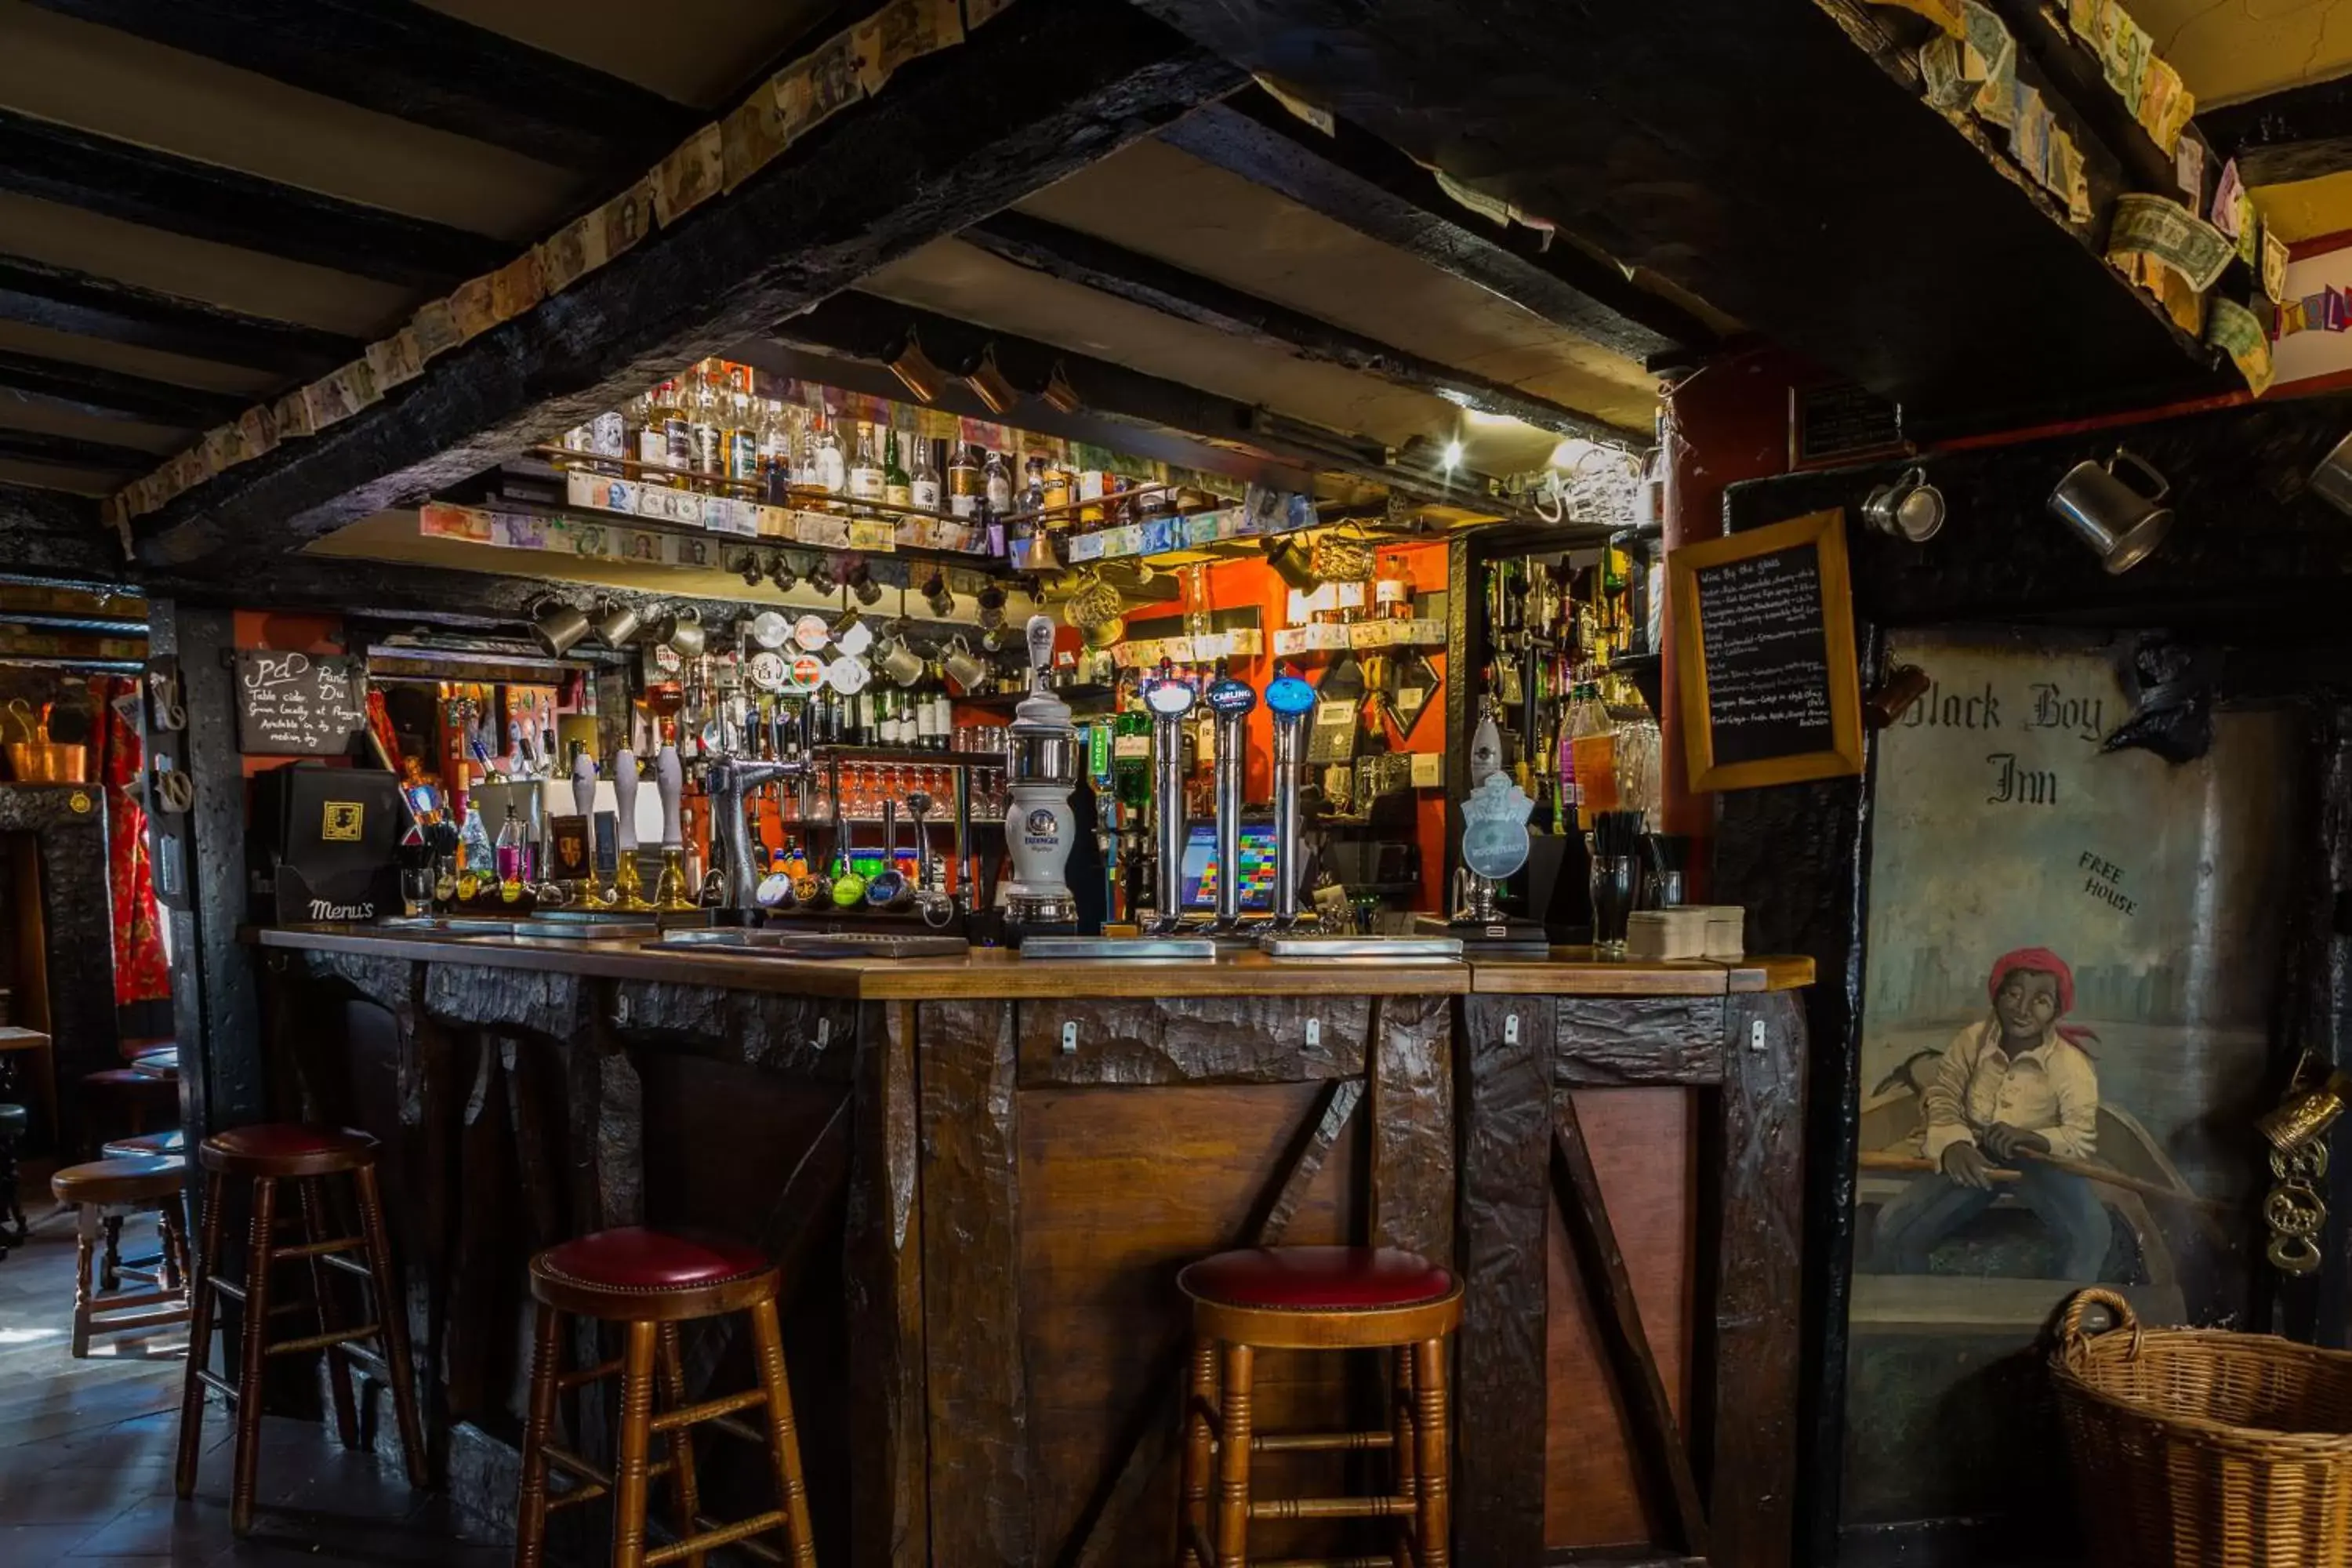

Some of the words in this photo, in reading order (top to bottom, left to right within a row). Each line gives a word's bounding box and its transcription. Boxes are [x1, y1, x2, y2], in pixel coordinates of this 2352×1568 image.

[1700, 572, 1721, 584] Wine
[1739, 563, 1754, 575] the
[317, 666, 349, 684] Pant
[249, 688, 277, 702] Table
[318, 684, 346, 700] Du
[1213, 689, 1251, 702] CARLING
[2029, 682, 2105, 742] Boy
[304, 732, 319, 747] dry
[1986, 753, 2056, 806] Inn
[2078, 850, 2126, 885] FREE
[2084, 876, 2139, 916] HOUSE
[307, 898, 375, 920] Menu's
